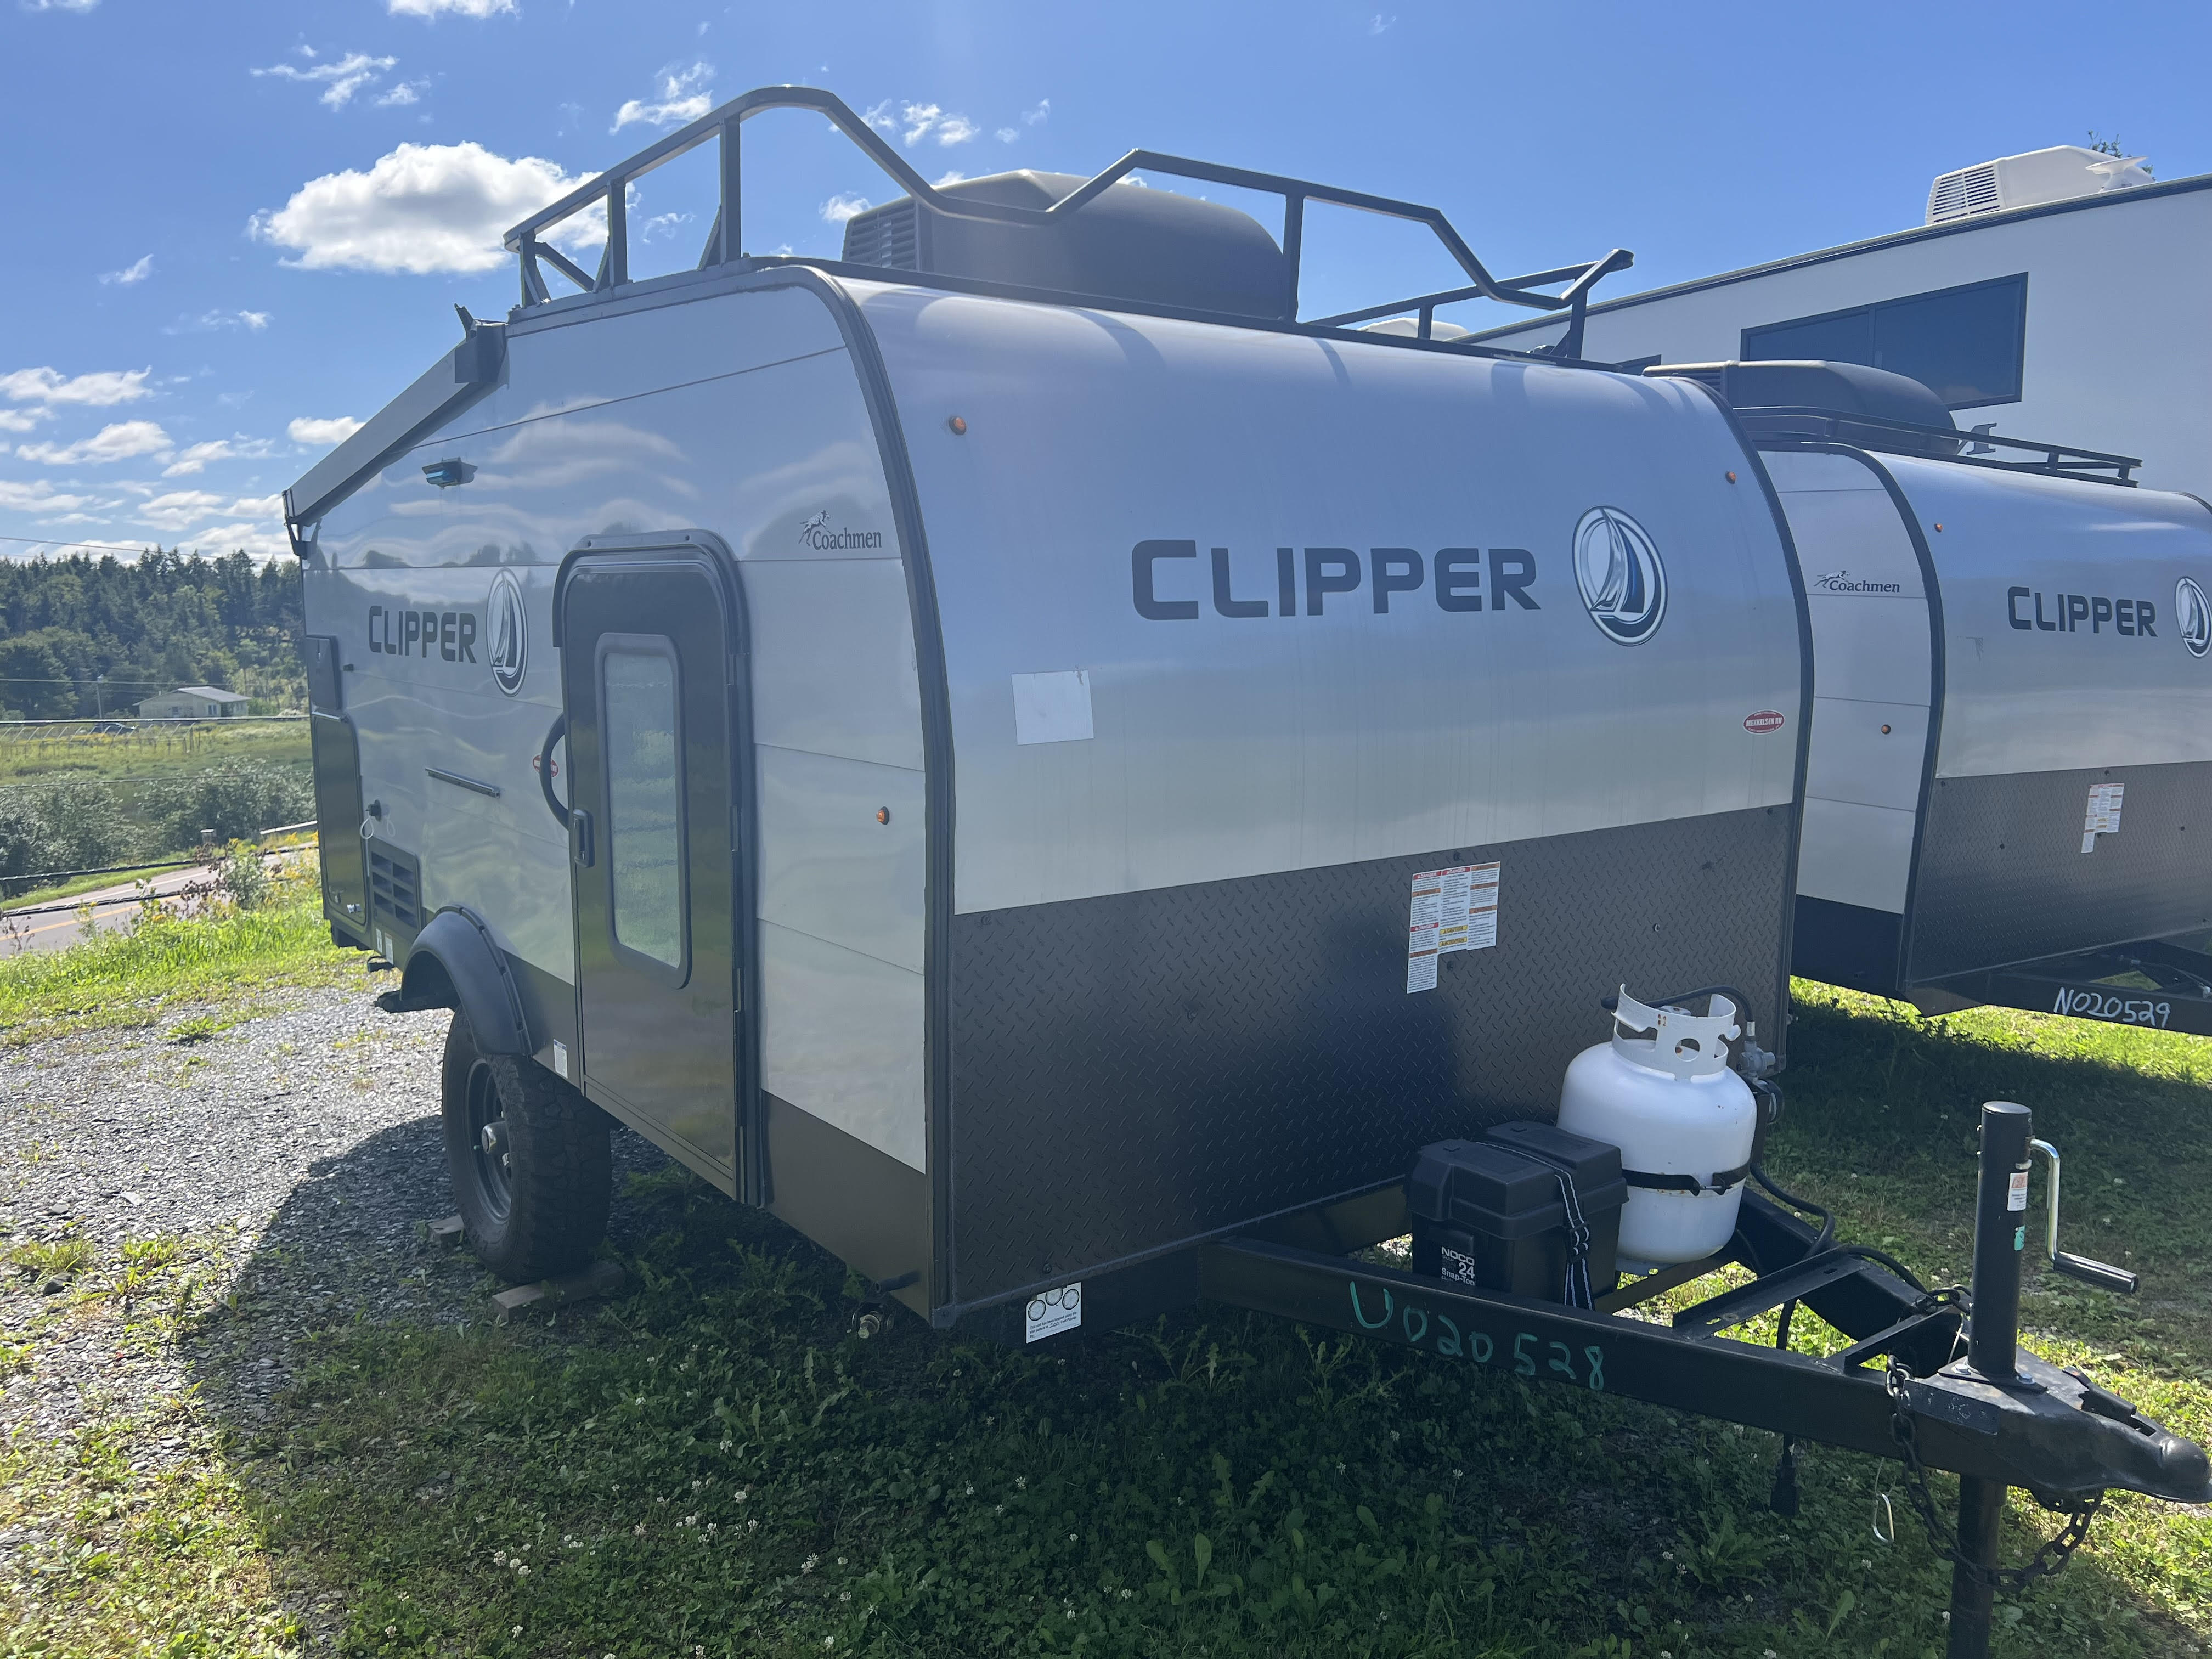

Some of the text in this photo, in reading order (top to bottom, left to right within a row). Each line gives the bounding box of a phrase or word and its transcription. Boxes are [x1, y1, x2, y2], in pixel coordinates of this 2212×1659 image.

[812, 527, 882, 550] Coachmen
[1132, 540, 1542, 620] CLIPPER
[1829, 580, 1900, 592] Coachmen
[2007, 586, 2158, 637] CLIPPER
[369, 605, 477, 664] CLIPPER
[2053, 987, 2171, 1028] N020529
[1441, 1246, 1475, 1266] NOCO
[1458, 1262, 1475, 1279] 24
